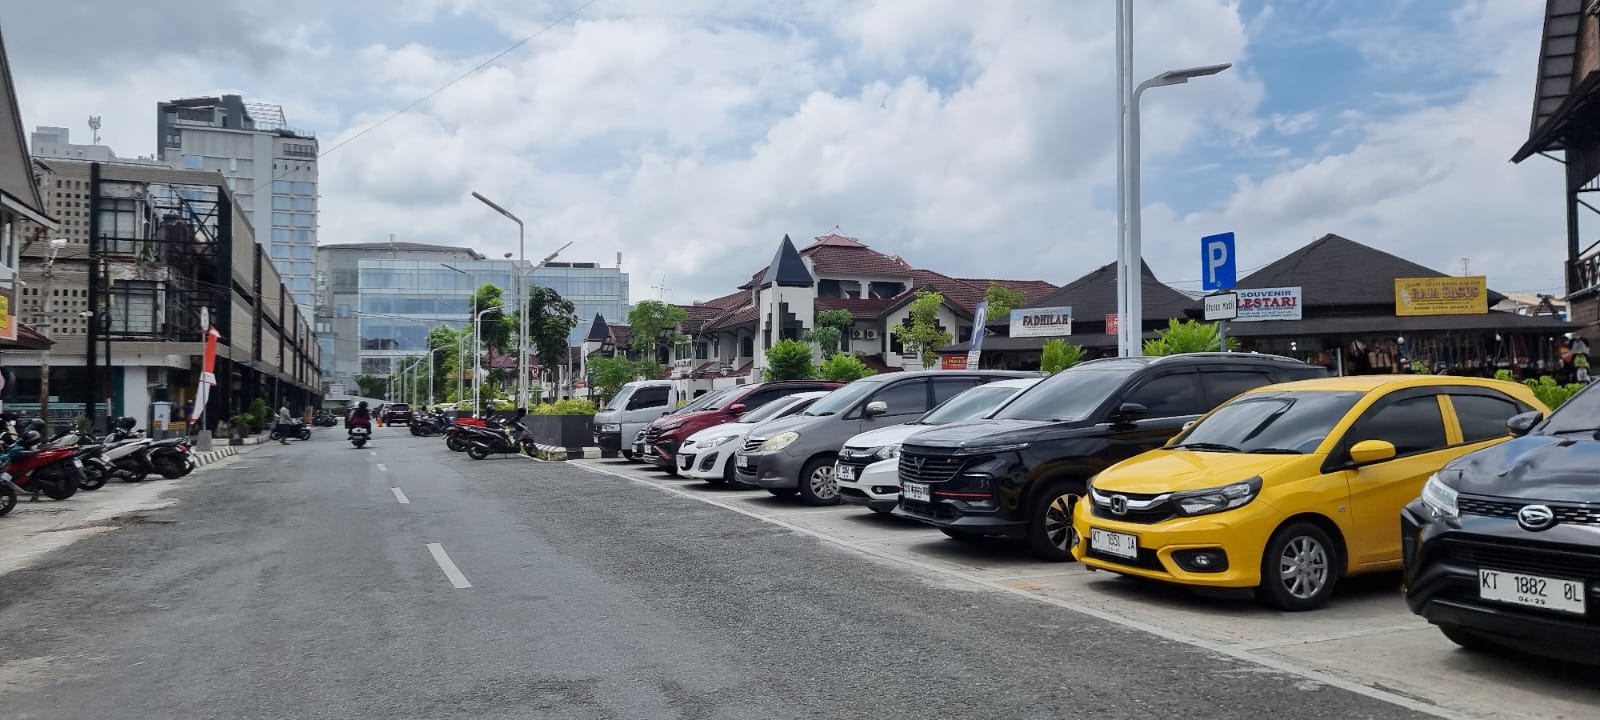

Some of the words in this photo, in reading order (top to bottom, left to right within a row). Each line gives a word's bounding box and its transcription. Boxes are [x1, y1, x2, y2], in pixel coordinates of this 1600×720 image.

[1208, 241, 1227, 284] P
[1240, 290, 1292, 298] SOUVENIR
[1237, 297, 1297, 308] LESTARI
[1023, 314, 1069, 327] FADHILAH
[1092, 530, 1100, 543] KT
[1482, 571, 1499, 590] KT
[1514, 576, 1548, 597] 1882
